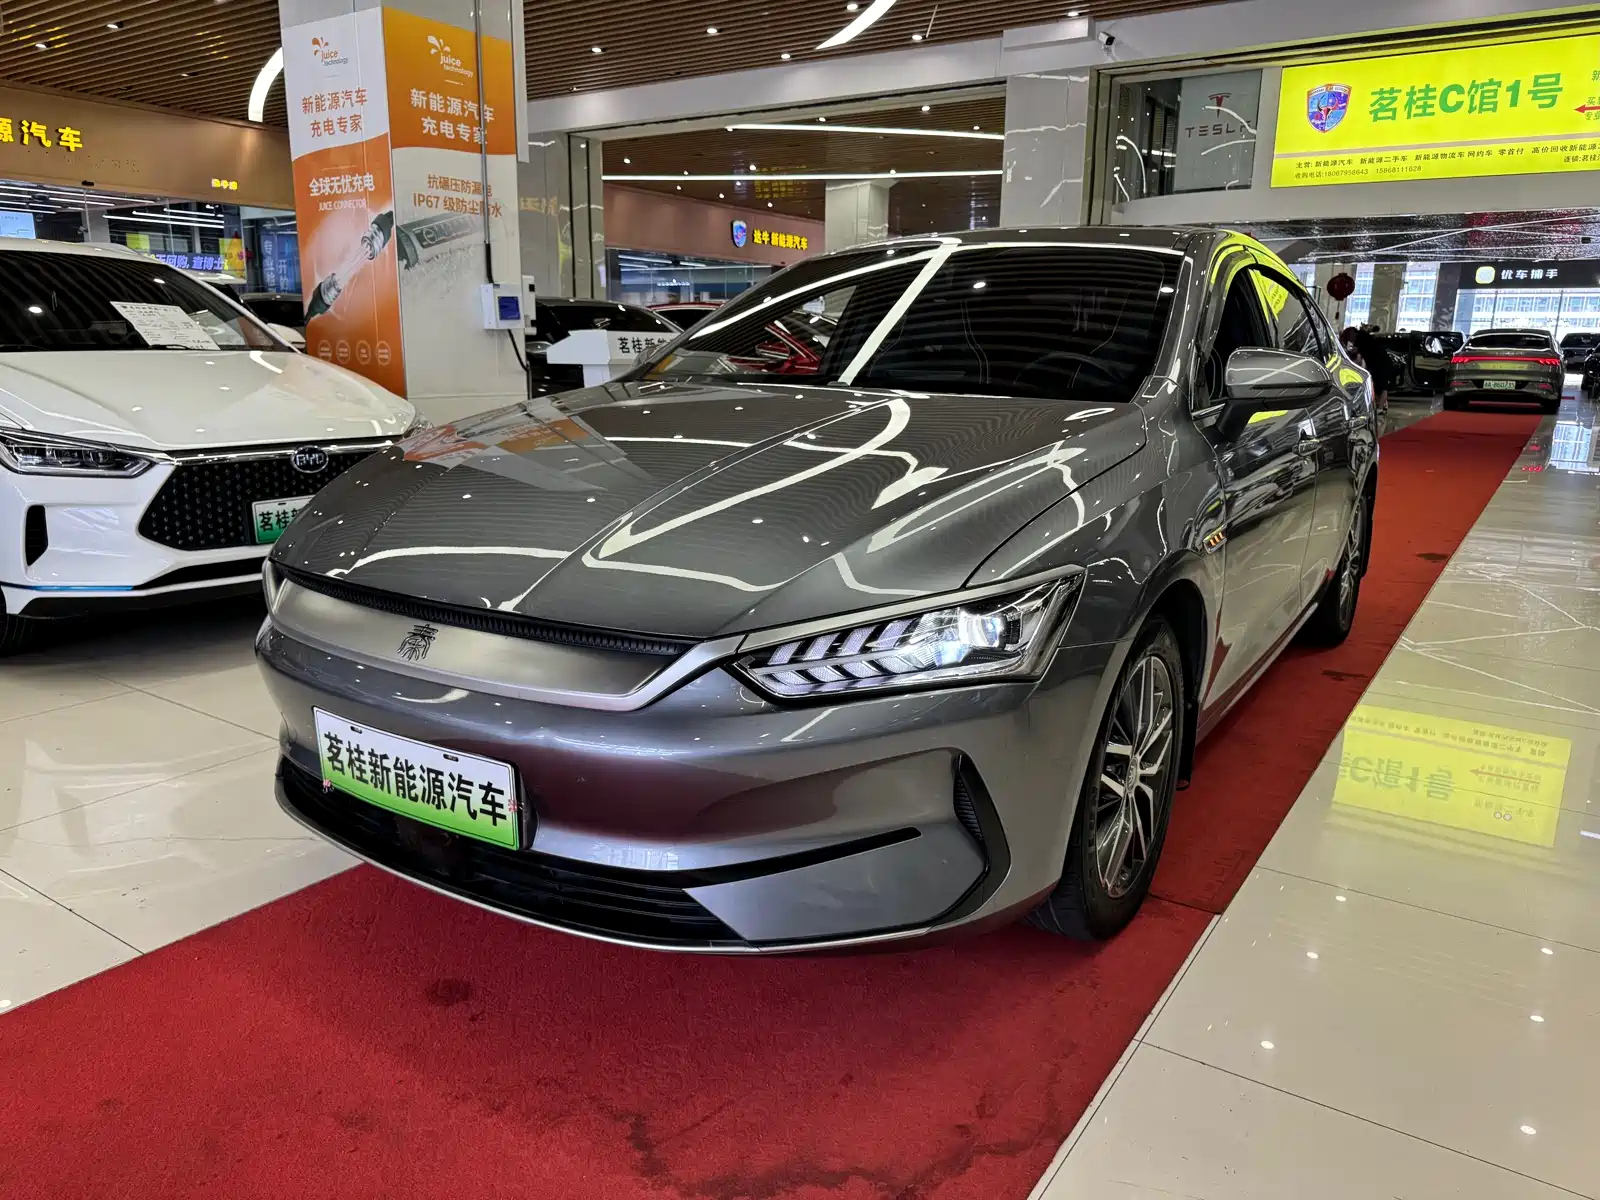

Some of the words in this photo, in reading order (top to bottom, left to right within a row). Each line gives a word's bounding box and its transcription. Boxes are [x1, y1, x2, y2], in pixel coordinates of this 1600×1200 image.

[321, 49, 338, 61] juice
[440, 53, 461, 66] juice
[443, 64, 474, 78] technology
[302, 87, 368, 114] 新能源汽车
[410, 88, 495, 123] 新能源汽车
[1368, 73, 1563, 123] 茗桂C馆1号
[310, 114, 362, 137] 充电专家
[421, 116, 488, 145] 充电专家
[1185, 120, 1251, 138] TESLA
[1315, 158, 1353, 168] 新能源汽车
[1360, 155, 1408, 165] 新能源二手车
[1415, 151, 1465, 161] 新能源物流车
[1467, 150, 1493, 158] 网约车
[1497, 147, 1524, 156] 零首付
[1531, 142, 1600, 154] 高价回收新能源
[308, 172, 376, 197] 全球无忧充电
[413, 193, 440, 210] IP67
[443, 195, 503, 218] 级防尘防水
[770, 231, 808, 250] 新能源汽车
[1501, 269, 1558, 280] 优车捕手
[296, 453, 325, 466] BYD
[323, 731, 508, 827] 茗桂新能源汽车
